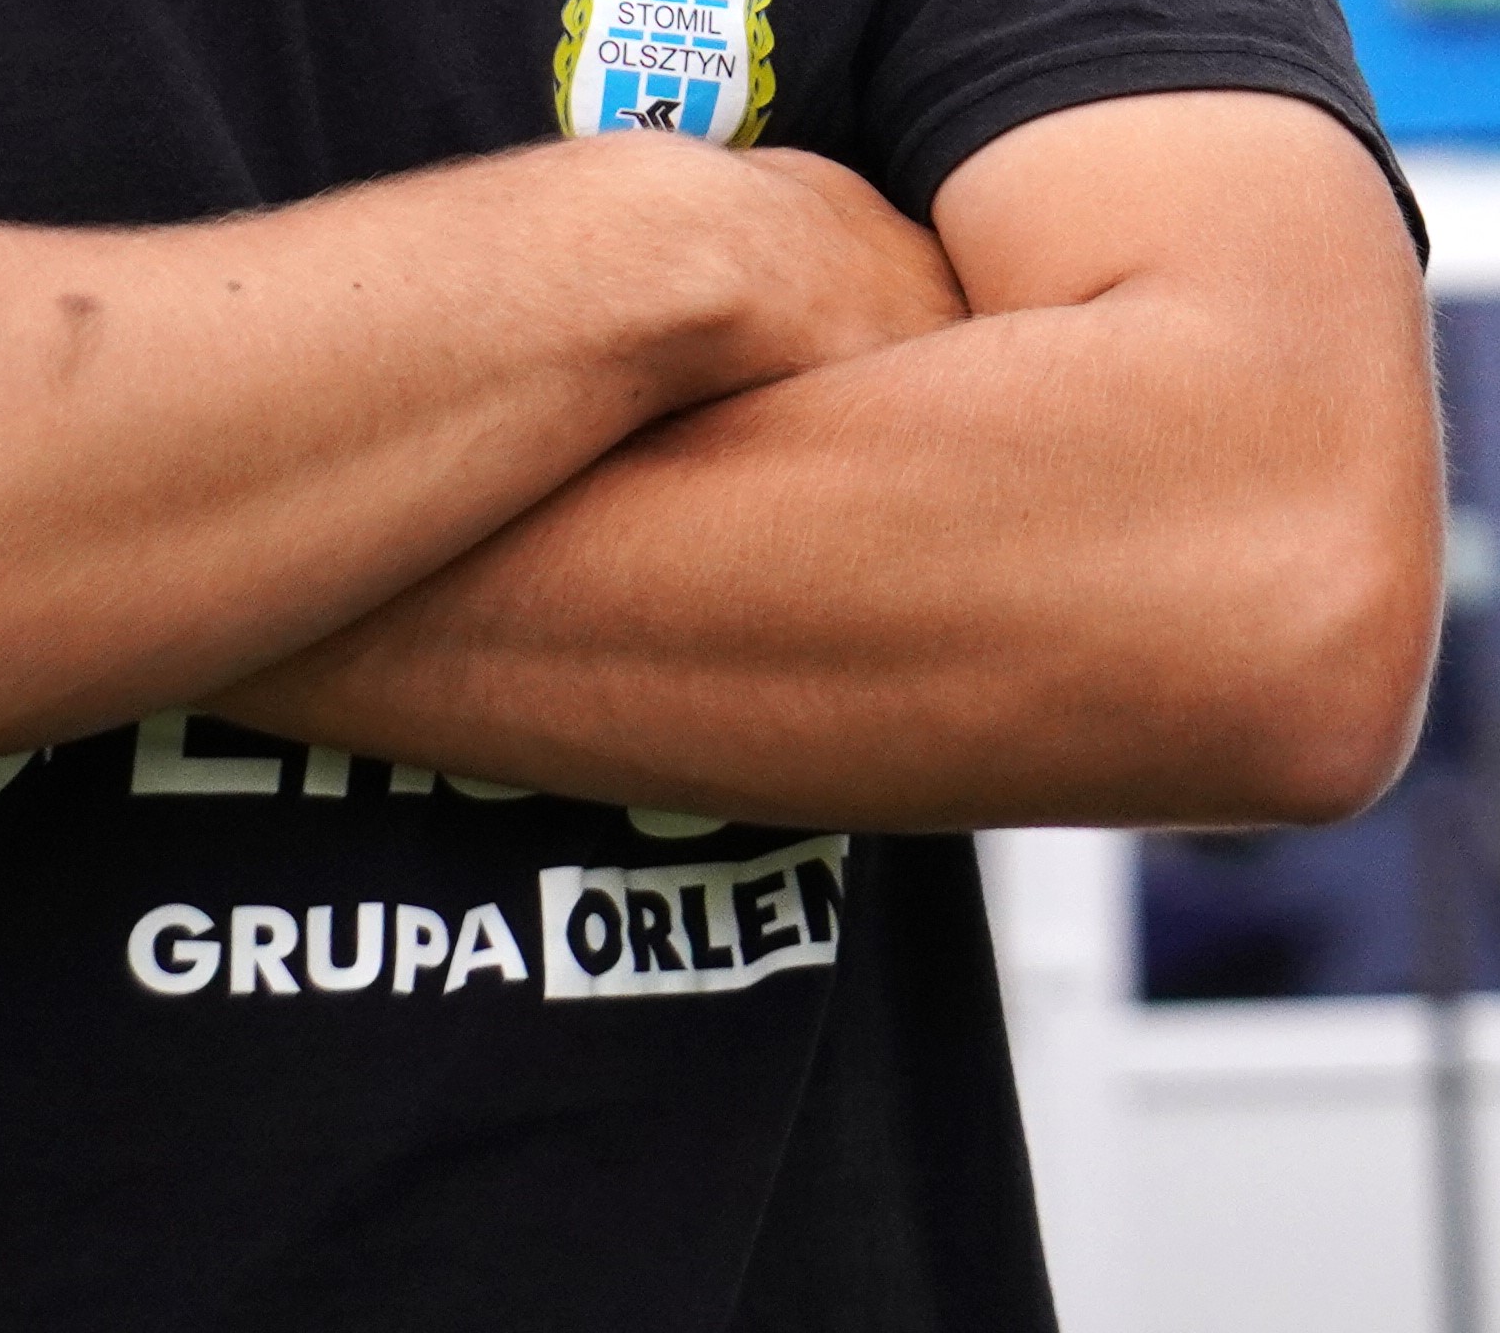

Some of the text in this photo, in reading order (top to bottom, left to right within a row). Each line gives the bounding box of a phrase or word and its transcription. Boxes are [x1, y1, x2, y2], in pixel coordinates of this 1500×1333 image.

[617, 1, 722, 36] STOMIL
[598, 40, 737, 79] OLSZTYN
[127, 901, 528, 996] GRUPA
